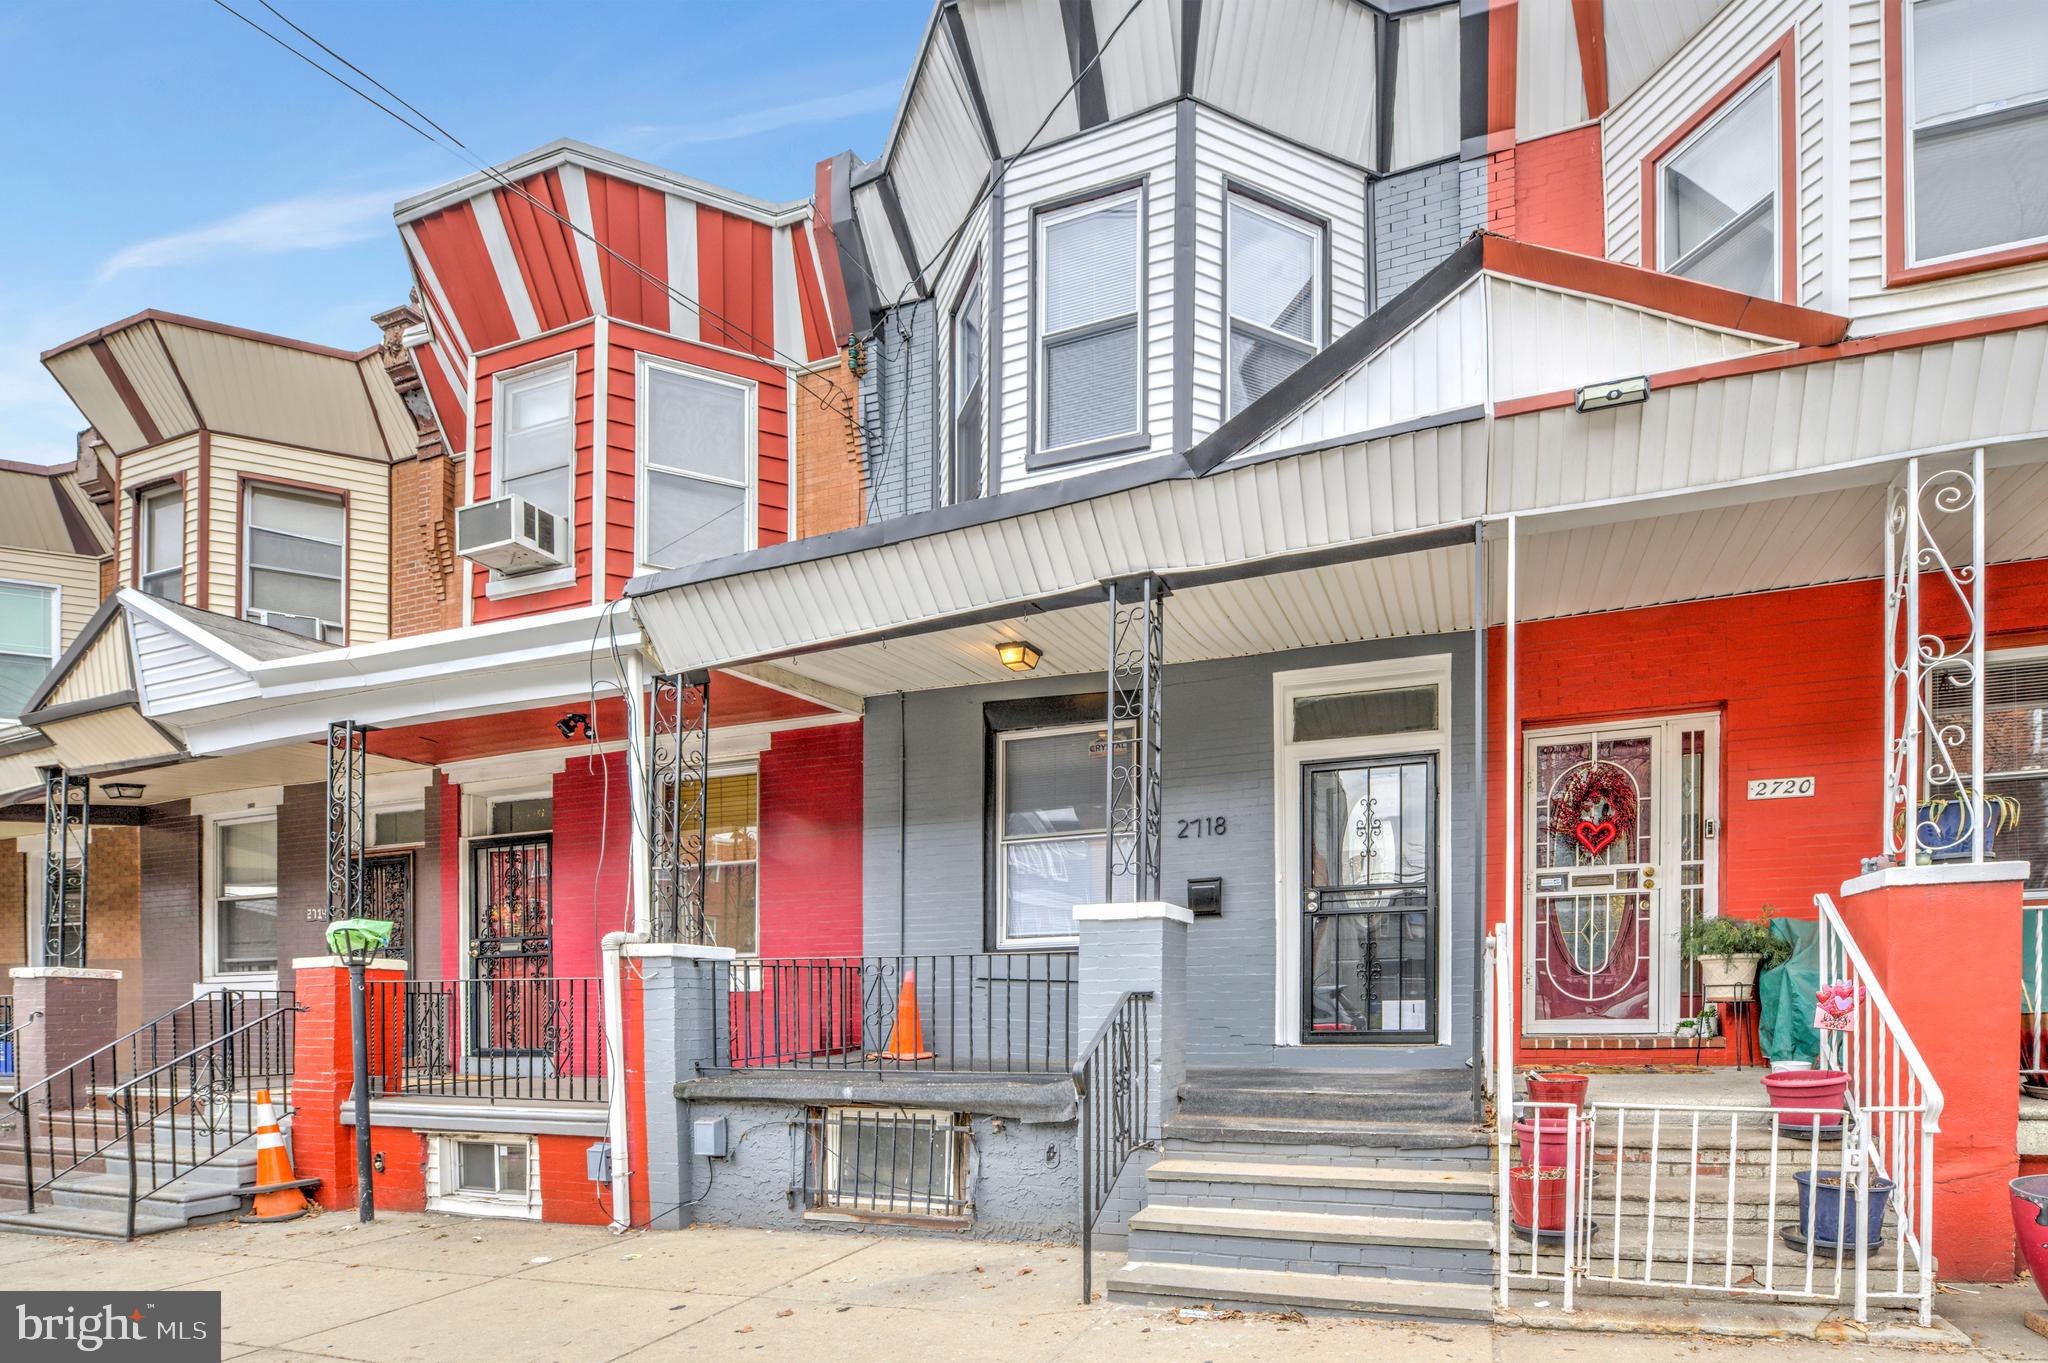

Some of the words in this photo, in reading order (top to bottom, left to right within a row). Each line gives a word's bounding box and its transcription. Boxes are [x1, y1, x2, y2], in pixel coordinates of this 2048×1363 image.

[1755, 779, 1811, 797] 2720
[1177, 816, 1226, 839] 2718
[306, 908, 327, 920] 2714
